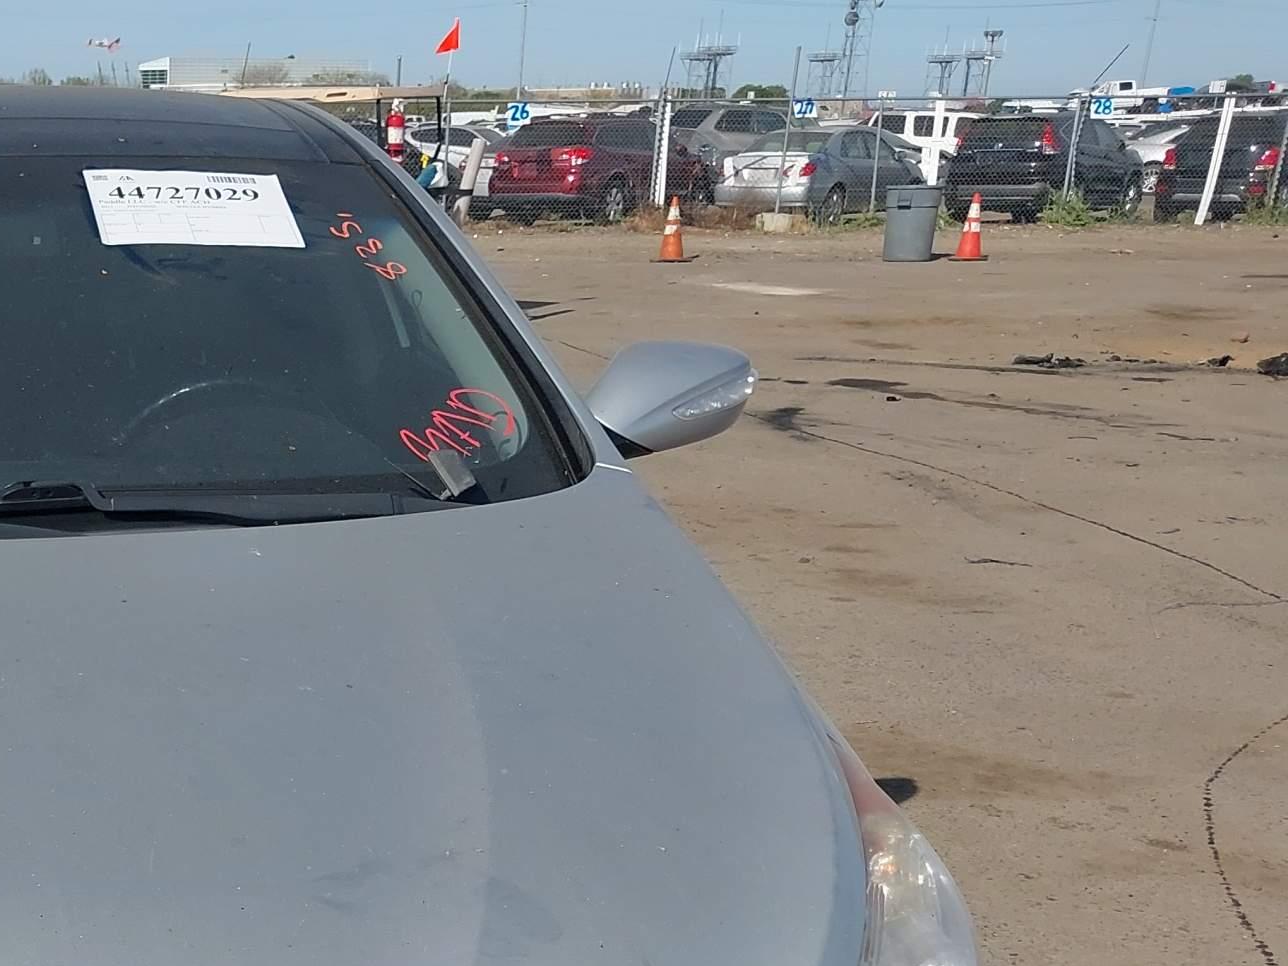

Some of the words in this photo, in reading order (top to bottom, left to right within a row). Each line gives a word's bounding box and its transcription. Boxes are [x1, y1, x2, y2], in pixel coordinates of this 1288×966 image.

[508, 102, 529, 121] 26
[1092, 98, 1113, 115] 28
[108, 185, 260, 202] 44727029
